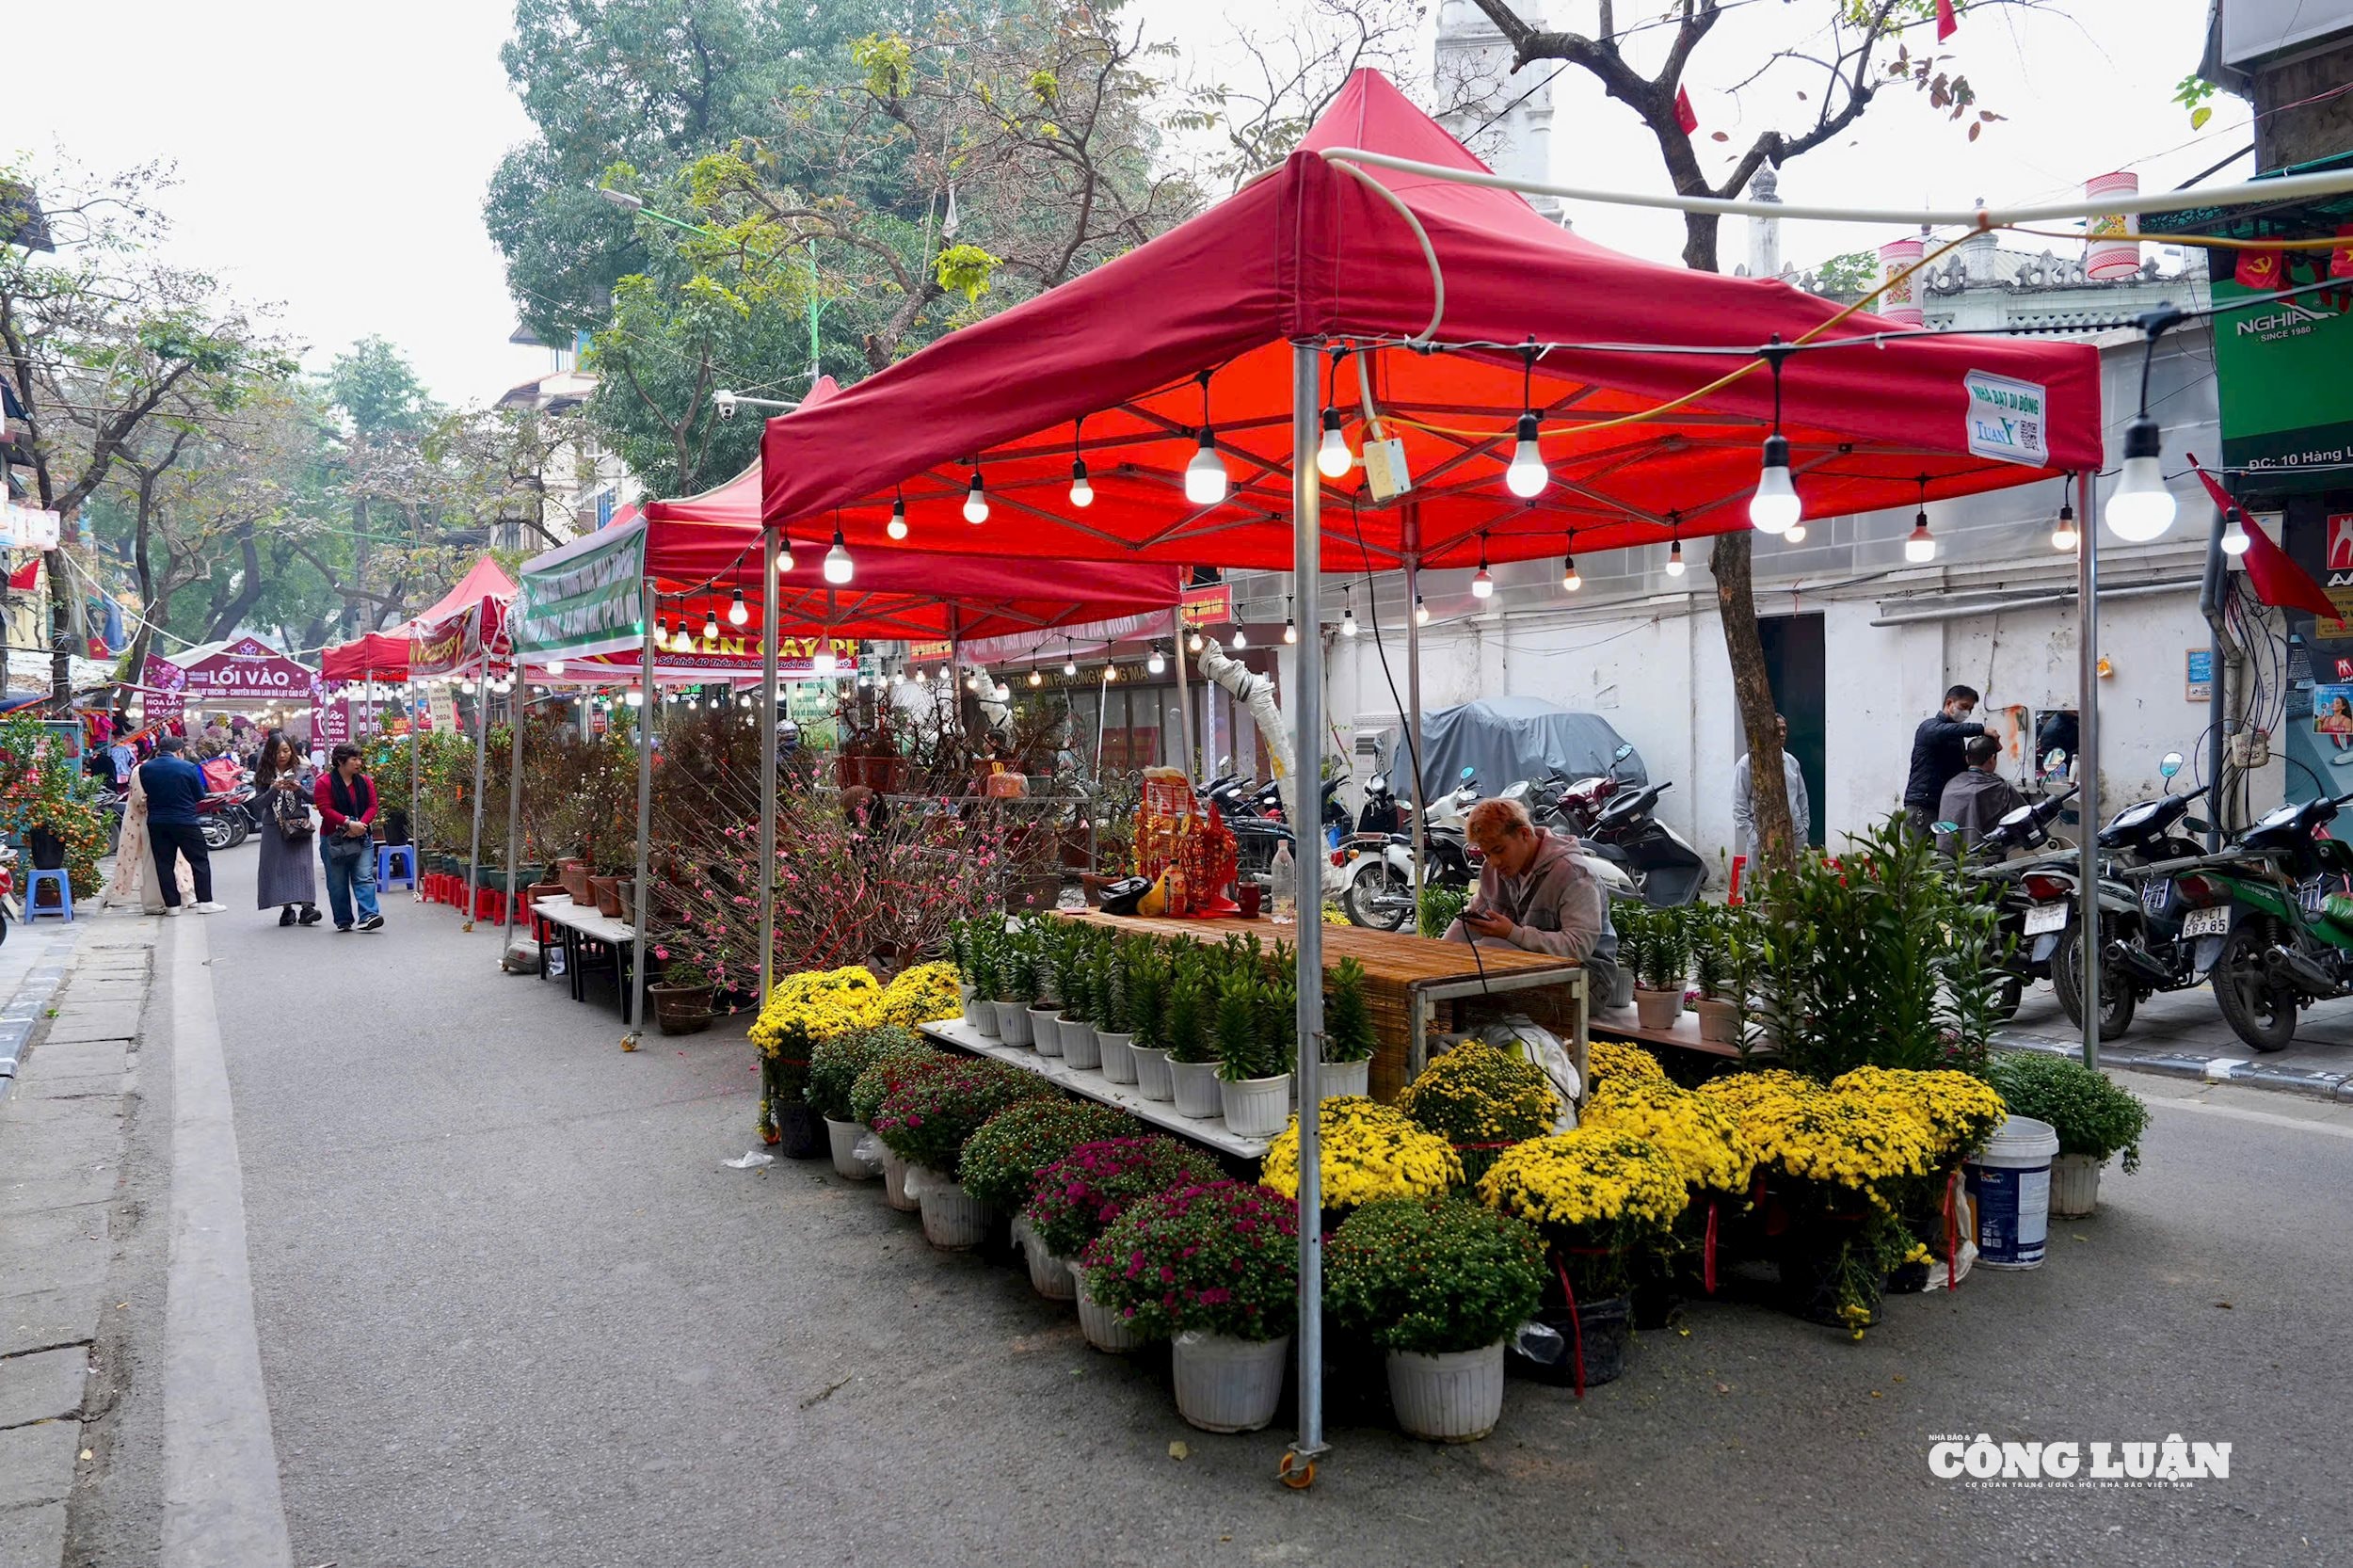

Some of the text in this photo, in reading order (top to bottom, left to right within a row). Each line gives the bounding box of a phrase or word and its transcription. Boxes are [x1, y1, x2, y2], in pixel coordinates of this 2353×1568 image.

[2261, 326, 2311, 342] SINCE 1980
[1972, 384, 1993, 403] NHÀ
[1992, 390, 2008, 410] BẠT
[2009, 393, 2018, 409] DI
[2281, 454, 2298, 466] 10
[2302, 450, 2343, 464] Hàng
[674, 656, 694, 666] nhà
[696, 658, 709, 666] 40
[734, 660, 748, 668] An
[1128, 662, 1149, 680] MÃ
[209, 664, 240, 685] LỐI
[245, 665, 290, 686] VÀO
[2190, 906, 2222, 924] 29-C1
